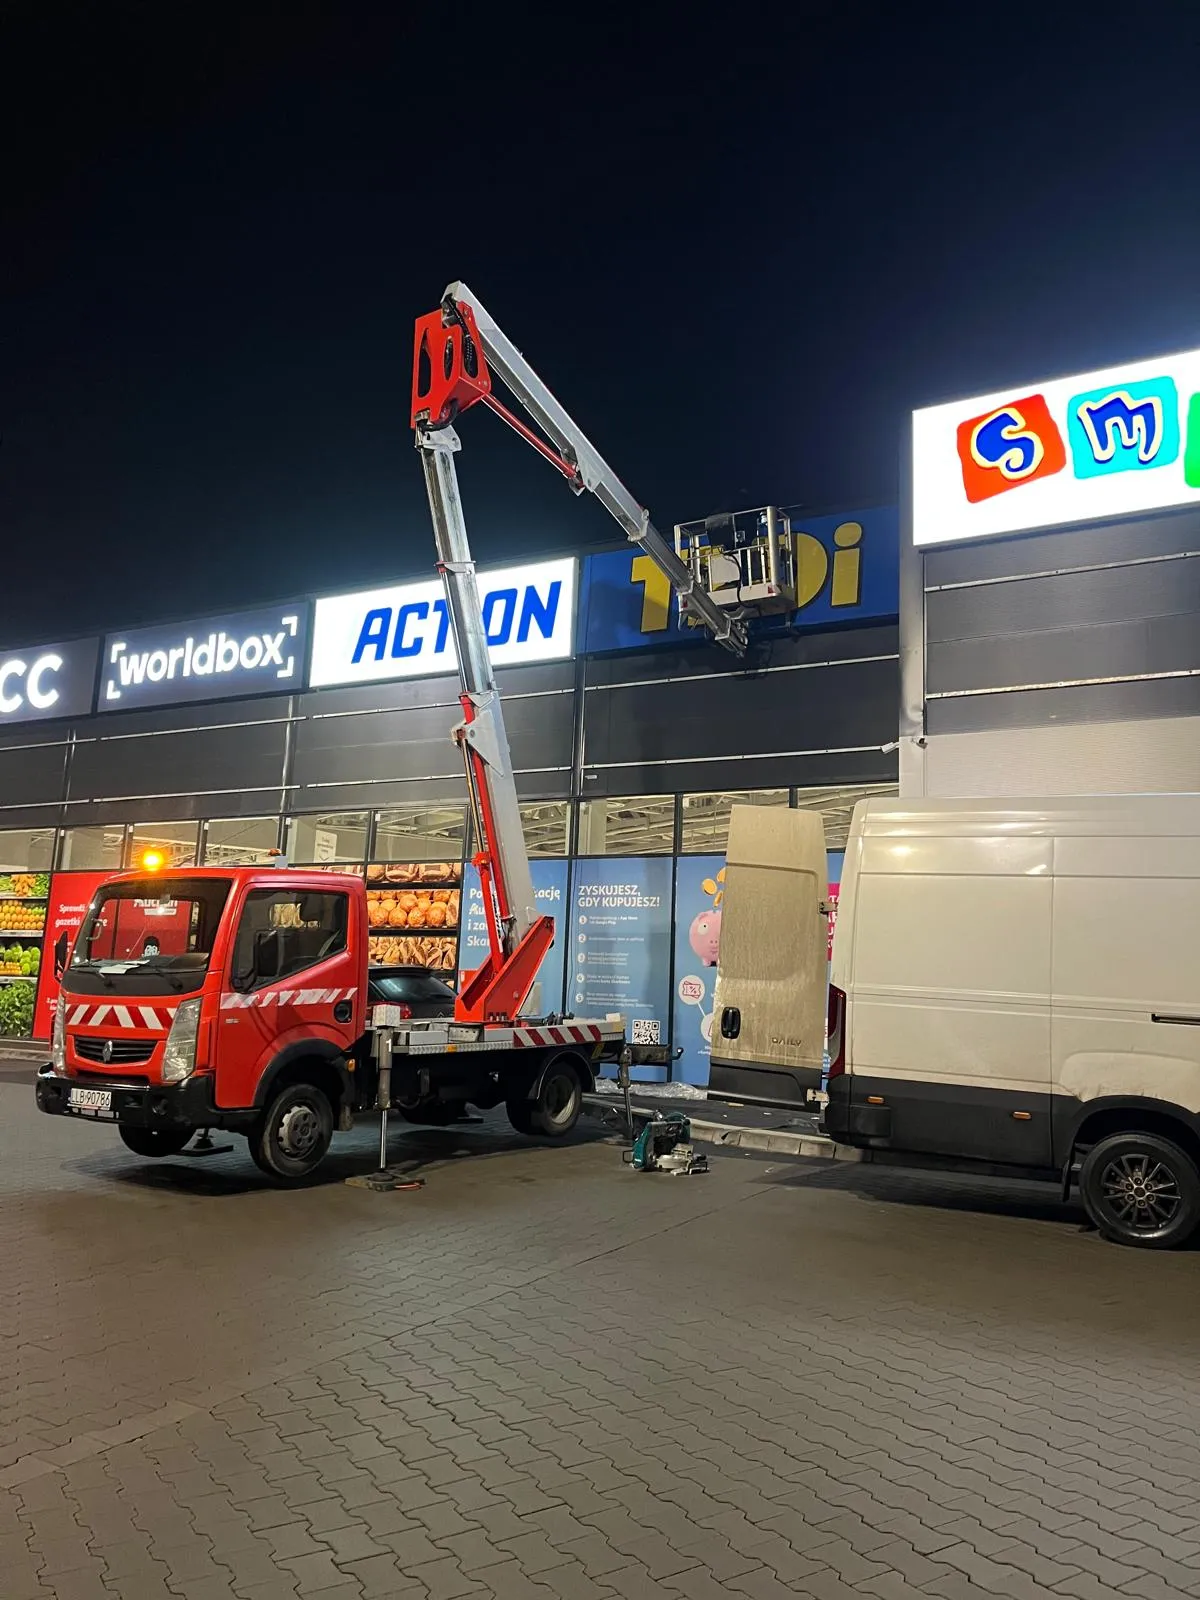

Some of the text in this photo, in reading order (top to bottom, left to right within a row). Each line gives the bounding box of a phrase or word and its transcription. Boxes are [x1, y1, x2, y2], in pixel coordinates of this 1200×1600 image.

[351, 581, 562, 664] ACTON
[119, 632, 286, 686] worldbox
[578, 885, 641, 897] ZYSKUJESZ,
[578, 896, 660, 908] GDY KUPUJESZ!
